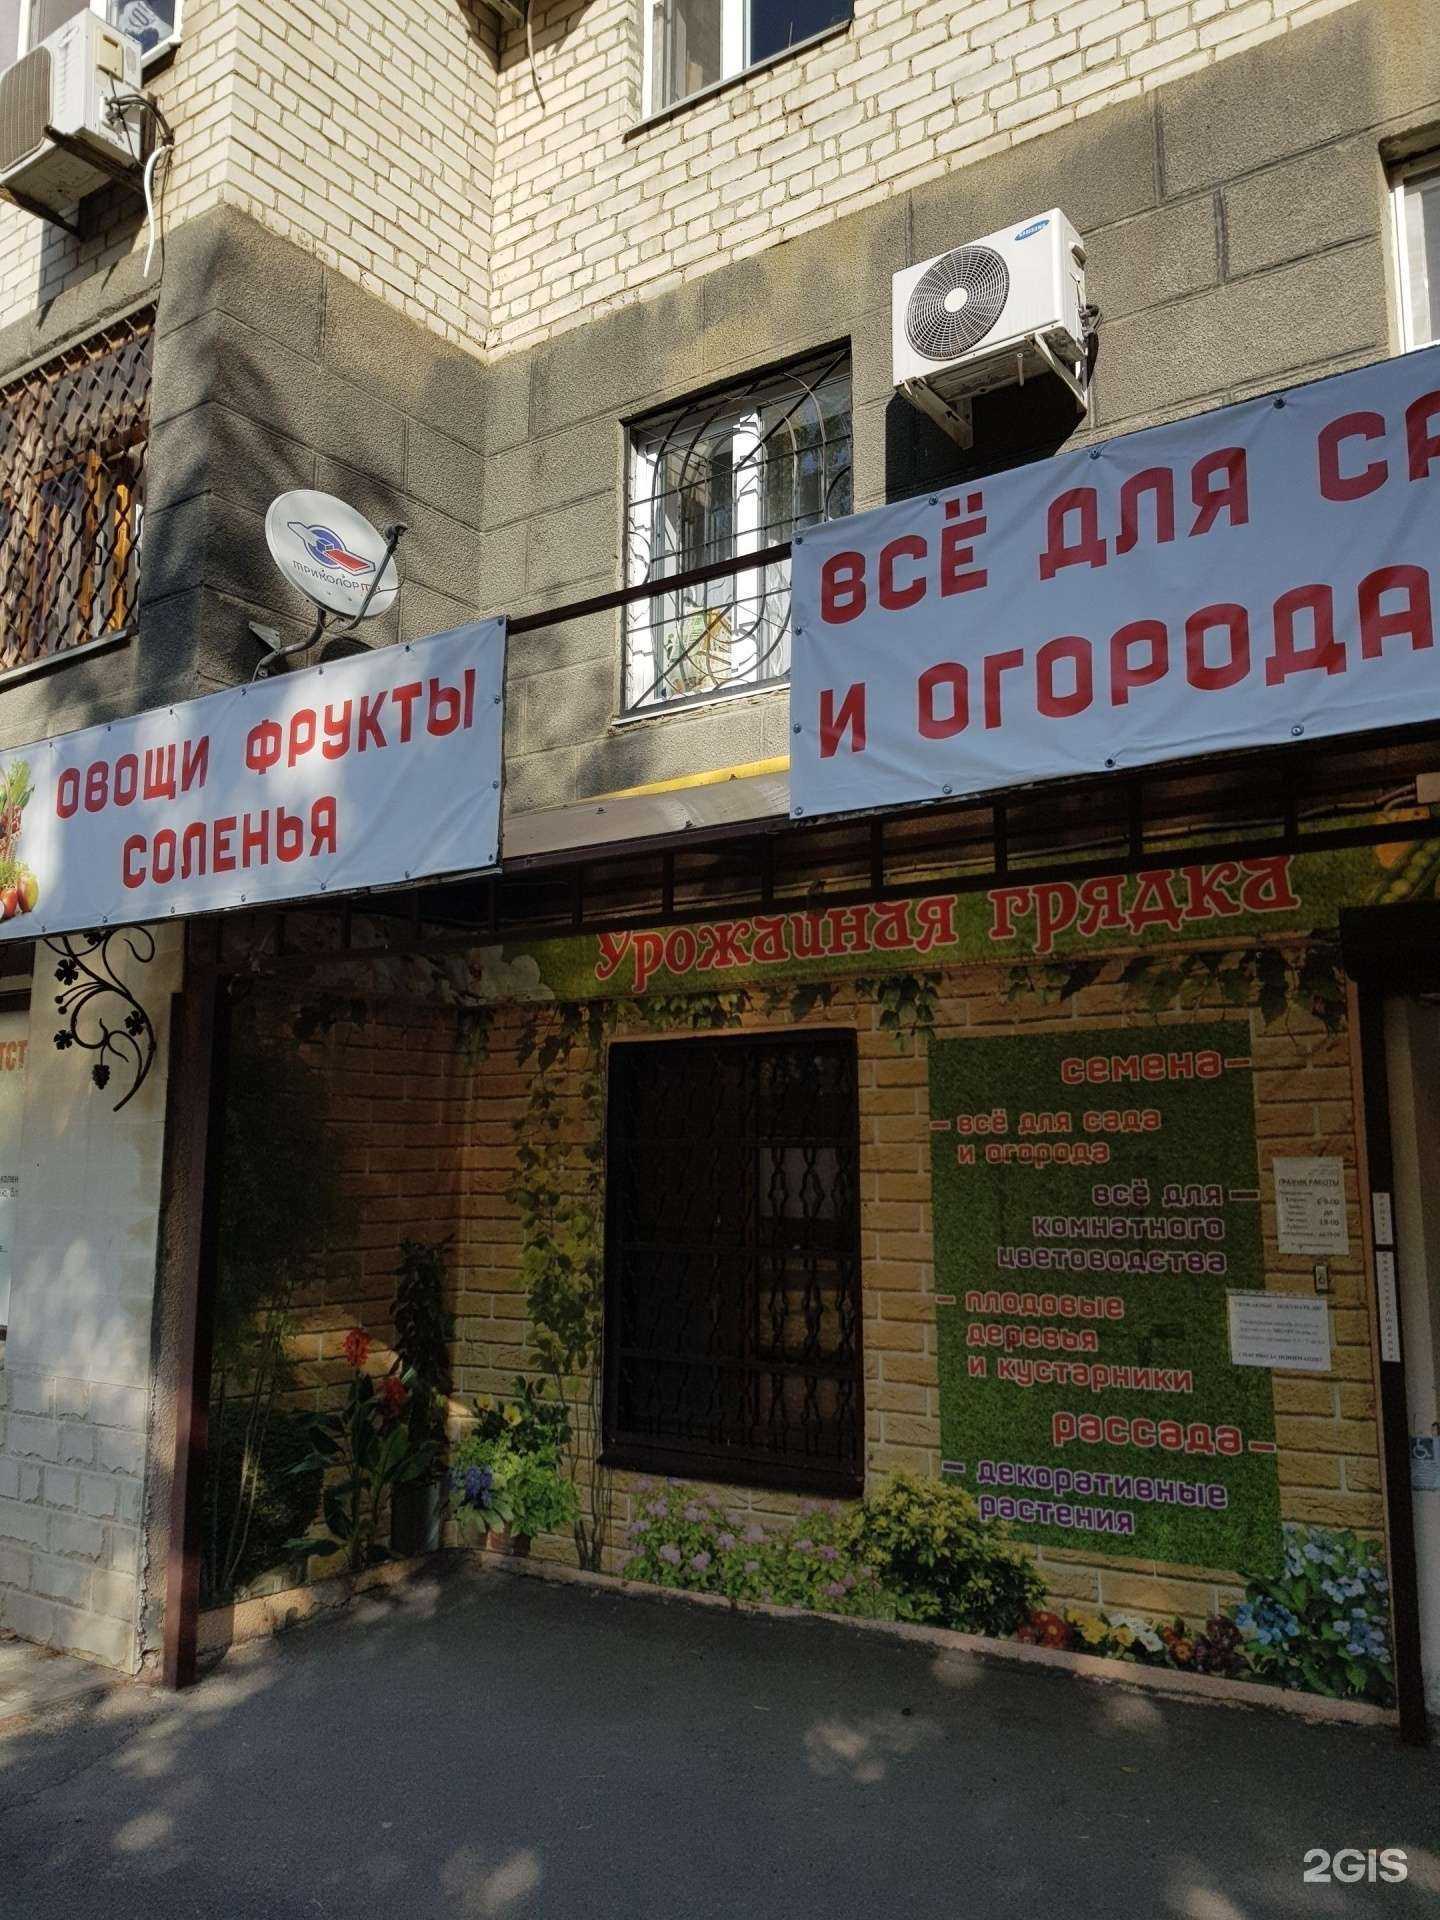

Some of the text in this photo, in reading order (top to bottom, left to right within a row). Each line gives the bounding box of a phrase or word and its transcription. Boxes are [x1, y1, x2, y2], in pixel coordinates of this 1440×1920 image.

[820, 491, 988, 625] ВСЁ
[1039, 446, 1249, 581] ДЛЯ
[819, 564, 1434, 758] И ОГОРОДА
[56, 669, 476, 819] ОВОЩИ ФРУКТЫ
[122, 795, 338, 889] СОЛЕНЬЯ
[1061, 1050, 1222, 1084] семена
[956, 1109, 1161, 1134] всё для сада
[957, 1141, 1110, 1168] и огорода
[1092, 1178, 1223, 1206] всё для
[1032, 1216, 1225, 1240] комнатного
[997, 1246, 1227, 1273] цветоводства
[965, 1290, 1124, 1319] плодовые
[966, 1323, 1098, 1351] деревья
[967, 1356, 1193, 1393] и кустарники
[1053, 1411, 1243, 1455] рассада
[977, 1461, 1227, 1509] декоративные
[978, 1495, 1135, 1535] растения
